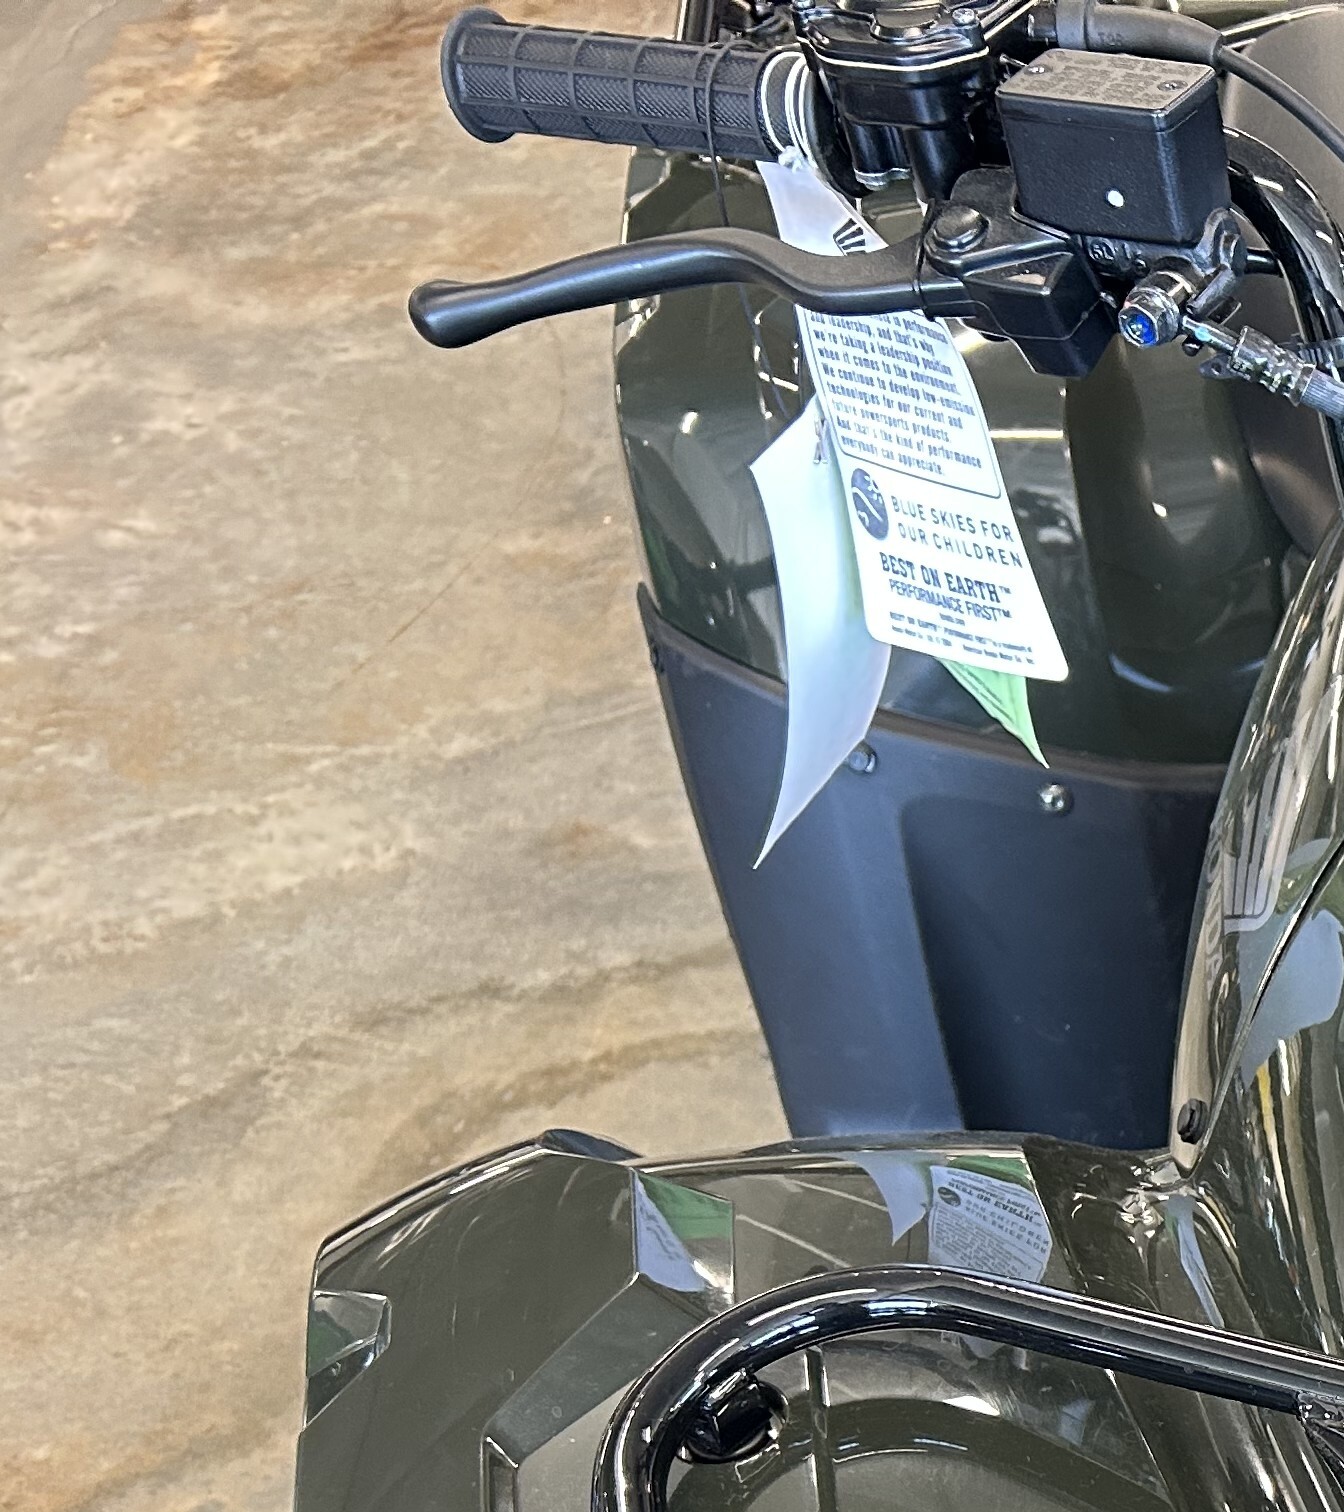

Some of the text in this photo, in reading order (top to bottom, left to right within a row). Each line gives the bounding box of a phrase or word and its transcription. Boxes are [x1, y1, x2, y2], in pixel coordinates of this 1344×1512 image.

[881, 360, 891, 374] to
[877, 377, 886, 390] to
[889, 380, 920, 400] develop
[891, 496, 1013, 542] BLUE SKIES FOR
[898, 522, 1022, 567] OUR CHILDREN
[880, 552, 915, 580] BEST
[920, 565, 941, 588] ON
[889, 579, 963, 613] PERFORMANCE
